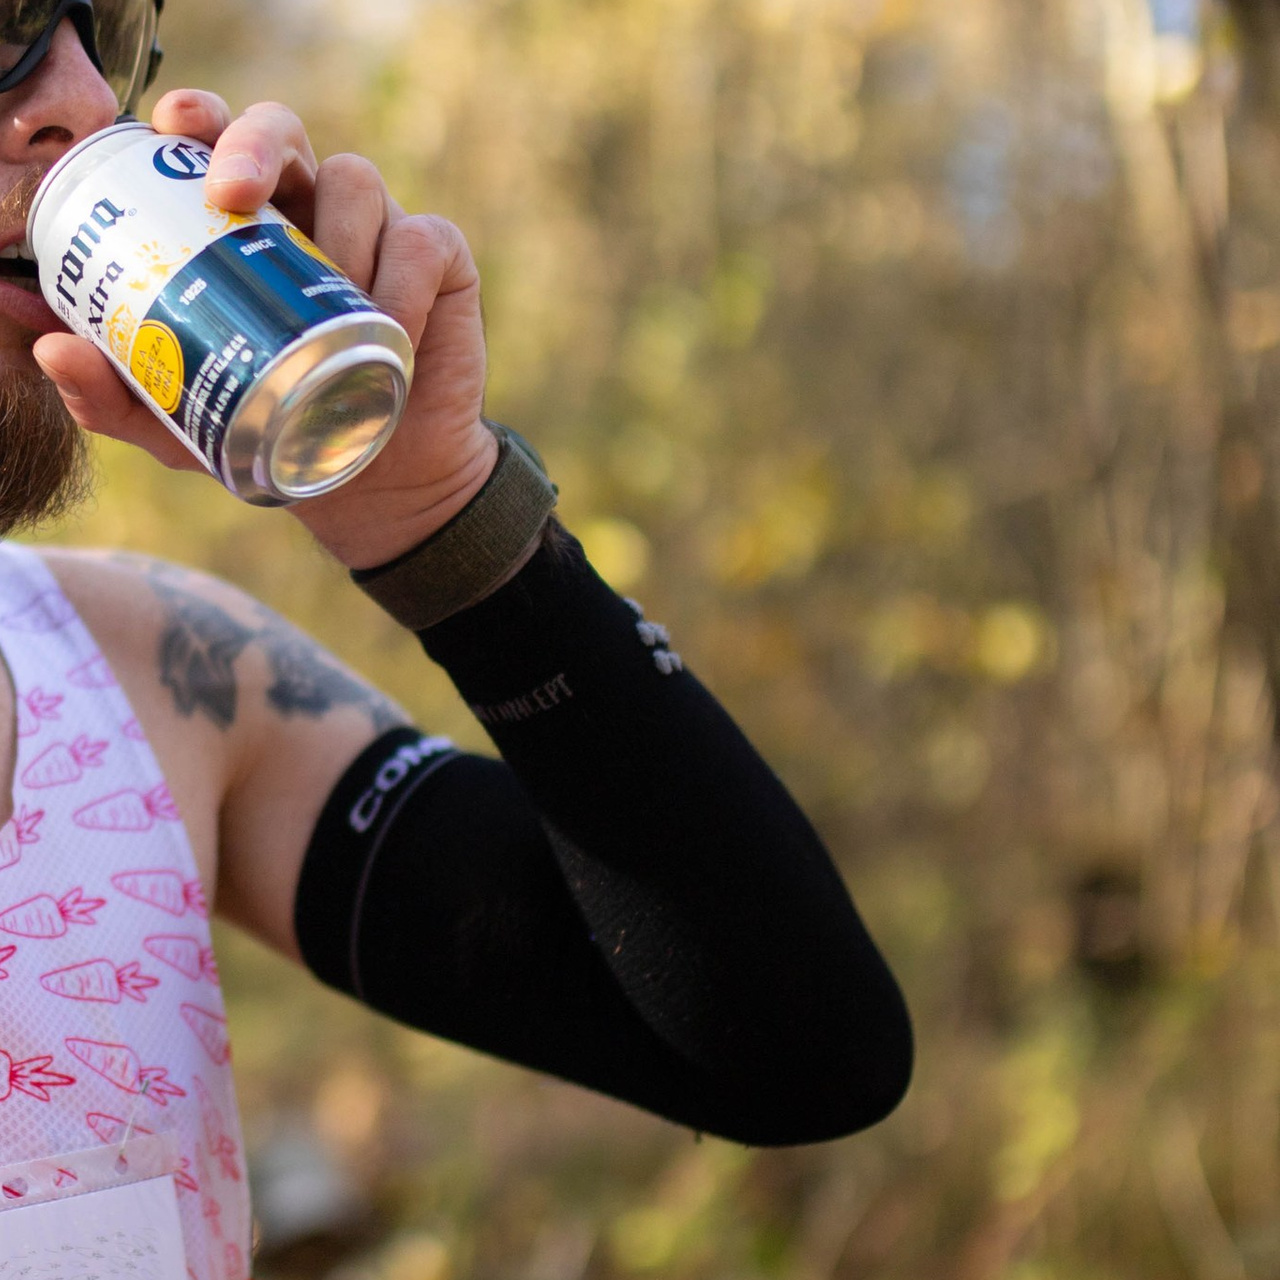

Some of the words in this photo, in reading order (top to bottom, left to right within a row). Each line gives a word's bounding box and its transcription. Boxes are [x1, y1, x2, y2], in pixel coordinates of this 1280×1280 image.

[240, 238, 276, 256] SINCE
[88, 261, 124, 340] xtra
[137, 350, 147, 368] LA
[144, 336, 164, 395] CERVEZA
[161, 370, 175, 400] FINA
